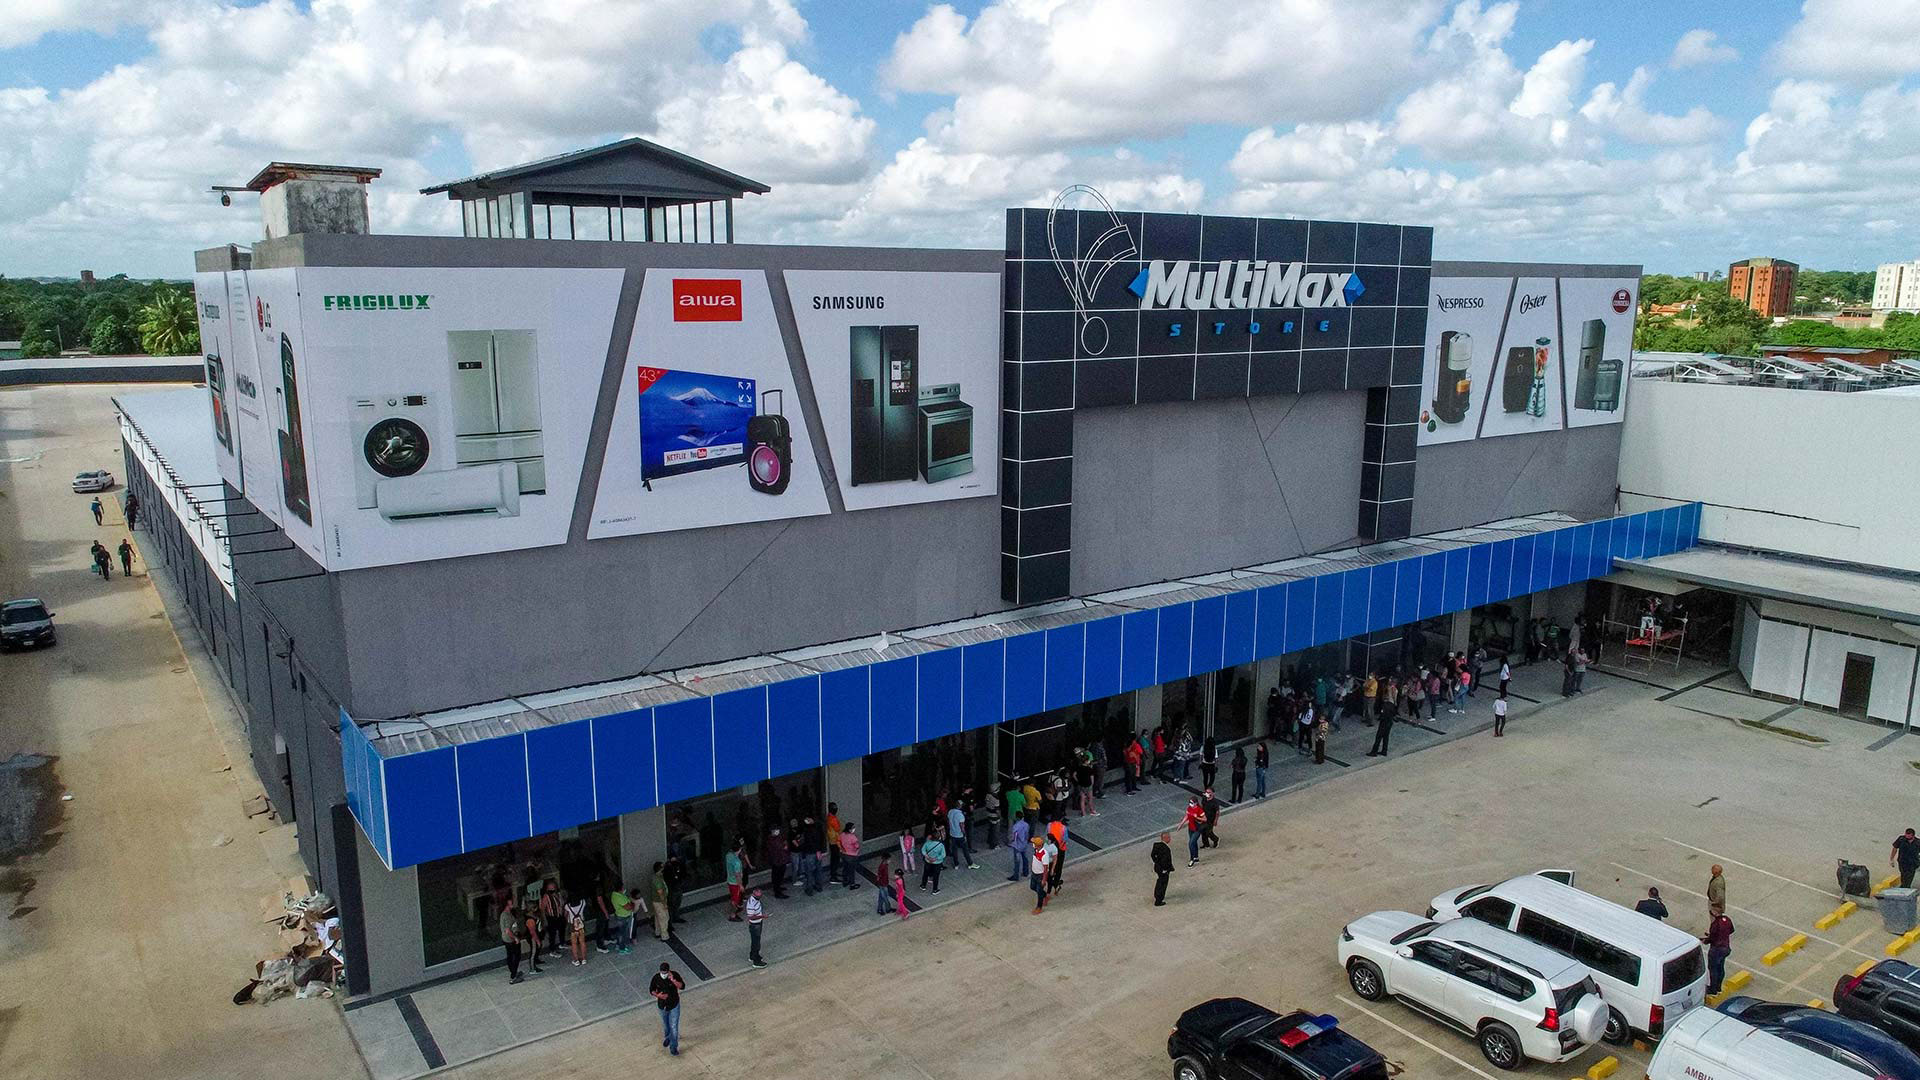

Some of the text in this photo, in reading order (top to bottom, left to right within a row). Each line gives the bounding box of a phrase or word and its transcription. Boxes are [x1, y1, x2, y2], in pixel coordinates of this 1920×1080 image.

[1140, 260, 1352, 310] MultiMax
[324, 295, 431, 311] FRIGILUX
[680, 294, 736, 307] aiwa
[813, 296, 885, 309] SAMSUNG
[1437, 294, 1484, 312] NESPRESSO
[1520, 294, 1547, 313] Oster
[1170, 320, 1330, 337] STORE
[666, 452, 686, 462] NETFLIX
